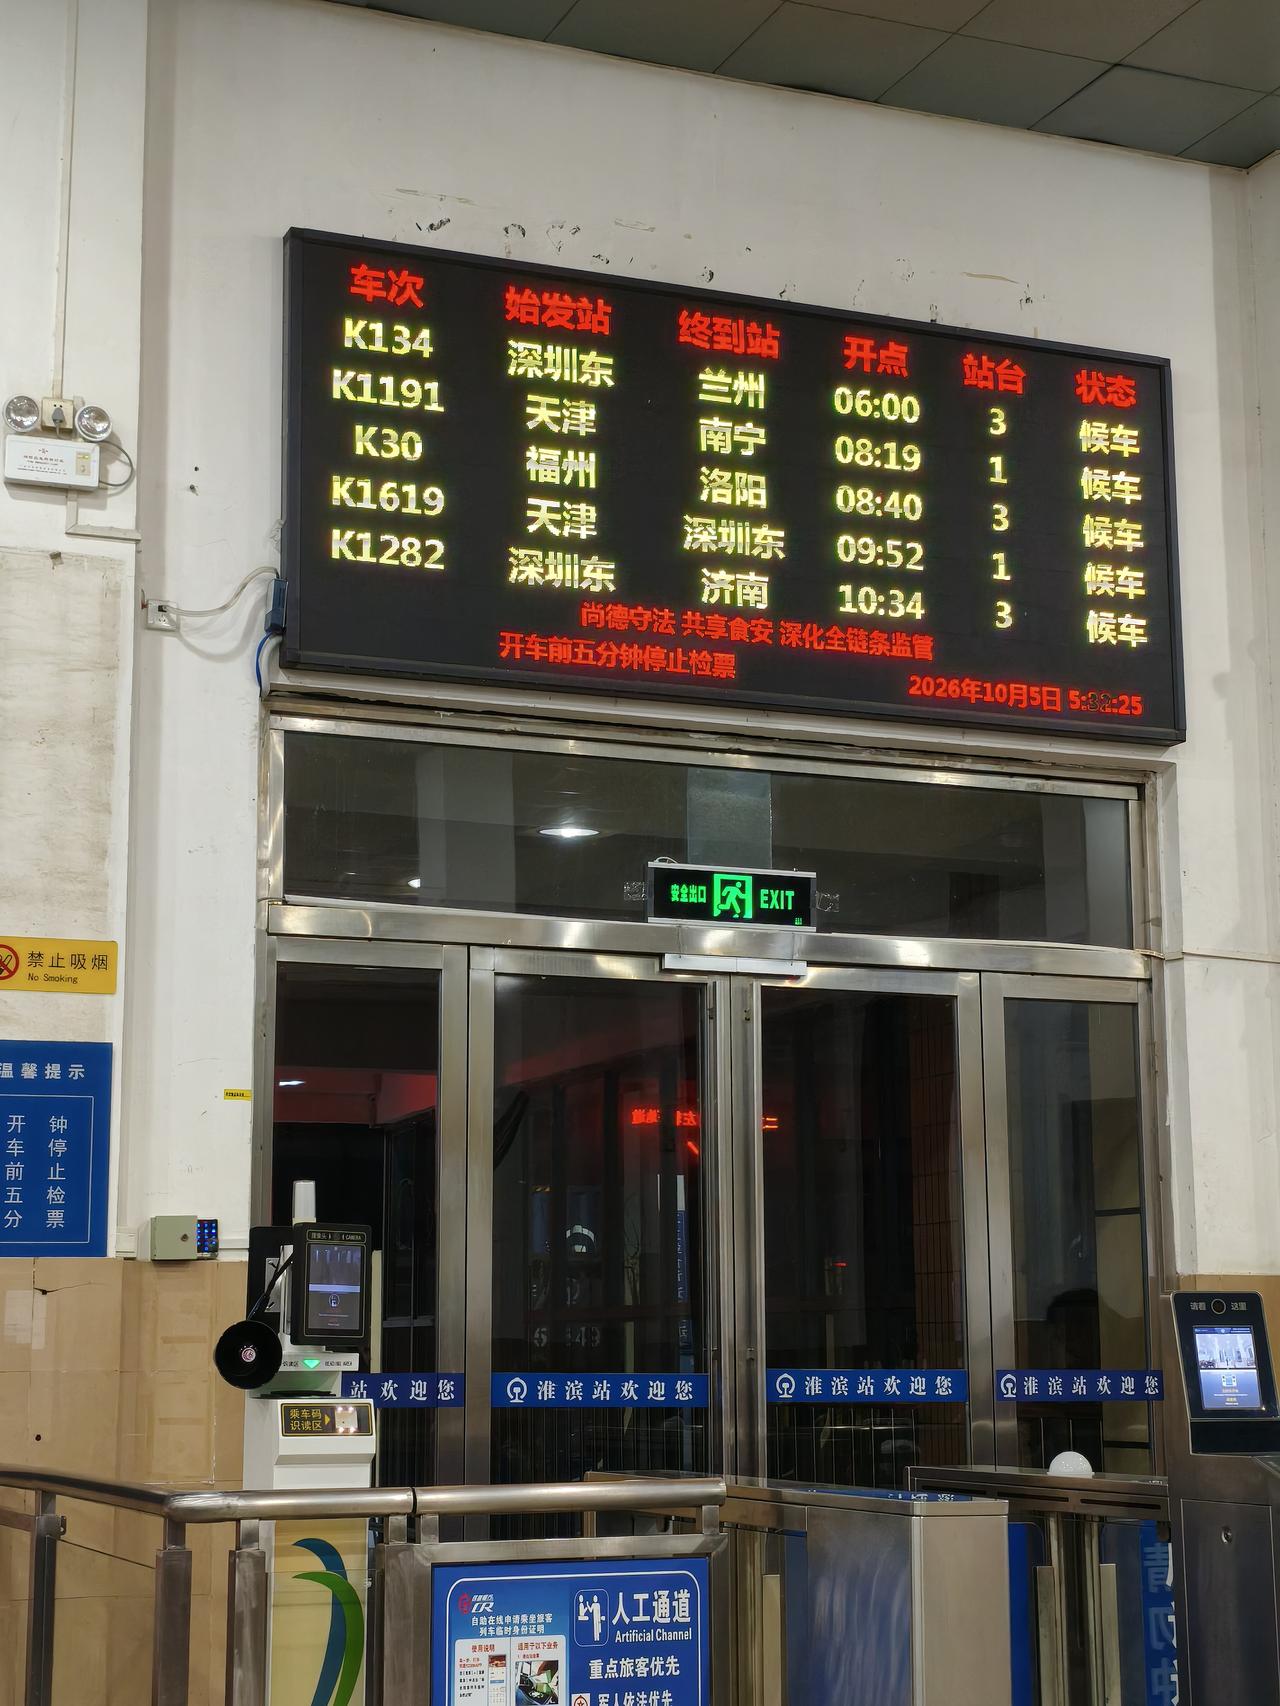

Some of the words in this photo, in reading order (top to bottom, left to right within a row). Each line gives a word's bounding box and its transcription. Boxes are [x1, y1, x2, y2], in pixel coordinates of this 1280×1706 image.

[350, 264, 424, 308] 车次
[504, 286, 612, 335] 始发站
[677, 311, 781, 358] 终到站
[843, 335, 909, 377] 开点
[963, 353, 1026, 394] 站台
[1075, 369, 1137, 408] 状态
[344, 317, 434, 359] K134
[507, 339, 615, 388] 深圳东
[699, 367, 766, 409] 兰州
[834, 386, 921, 424] 06:00
[990, 408, 1007, 436] 3
[1079, 419, 1141, 458] 候车
[332, 368, 445, 413] K1191
[526, 394, 597, 437] 天津
[699, 416, 767, 456] 南宁
[834, 435, 922, 473] 08:19
[990, 456, 1008, 484] 1
[1080, 466, 1142, 505] 候车
[355, 425, 423, 461] K30
[526, 445, 597, 489] 福州
[699, 466, 767, 509] 洛阳
[835, 485, 923, 521] 08:40
[992, 504, 1009, 532] 3
[1082, 513, 1144, 552] 候车
[332, 475, 445, 517] K1619
[526, 497, 598, 540] 天津
[683, 514, 786, 560] 深圳东
[836, 534, 924, 571] 09:52
[993, 552, 1011, 581] 1
[1084, 561, 1146, 600] 候车
[331, 528, 445, 570] K1282
[508, 546, 617, 593] 深圳东
[701, 567, 770, 610] 济南
[838, 584, 926, 620] 10:34
[995, 600, 1013, 629] 3
[1086, 609, 1148, 648] 候车
[580, 601, 677, 635] 尚德守法
[681, 610, 774, 645] 共享食安
[779, 619, 935, 661] 深化全链条监管
[499, 631, 737, 679] 开车前五分钟停止检票
[908, 674, 1062, 712] 2026年10月5日
[670, 883, 707, 904] 安全出口
[759, 888, 796, 910] EXIT
[27, 951, 109, 971] 禁止吸烟
[28, 972, 40, 982] No
[43, 973, 79, 985] Smoking
[0, 1062, 86, 1080] 温馨提示
[4, 1114, 26, 1229] 开车前五分
[46, 1115, 68, 1229] 钟停止检票
[349, 1379, 456, 1402] 站欢迎您
[536, 1379, 694, 1401] 淮滨站欢迎您
[804, 1375, 953, 1396] 淮滨站欢迎您
[1023, 1375, 1159, 1396] 淮滨站欢迎您
[290, 1420, 324, 1431] 识读区
[611, 1588, 692, 1626] 人工通道
[479, 1624, 545, 1637] 列车临时身份证明
[615, 1629, 654, 1644] Artificial
[655, 1627, 693, 1642] Channel
[588, 1655, 680, 1680] 重点旅客优先
